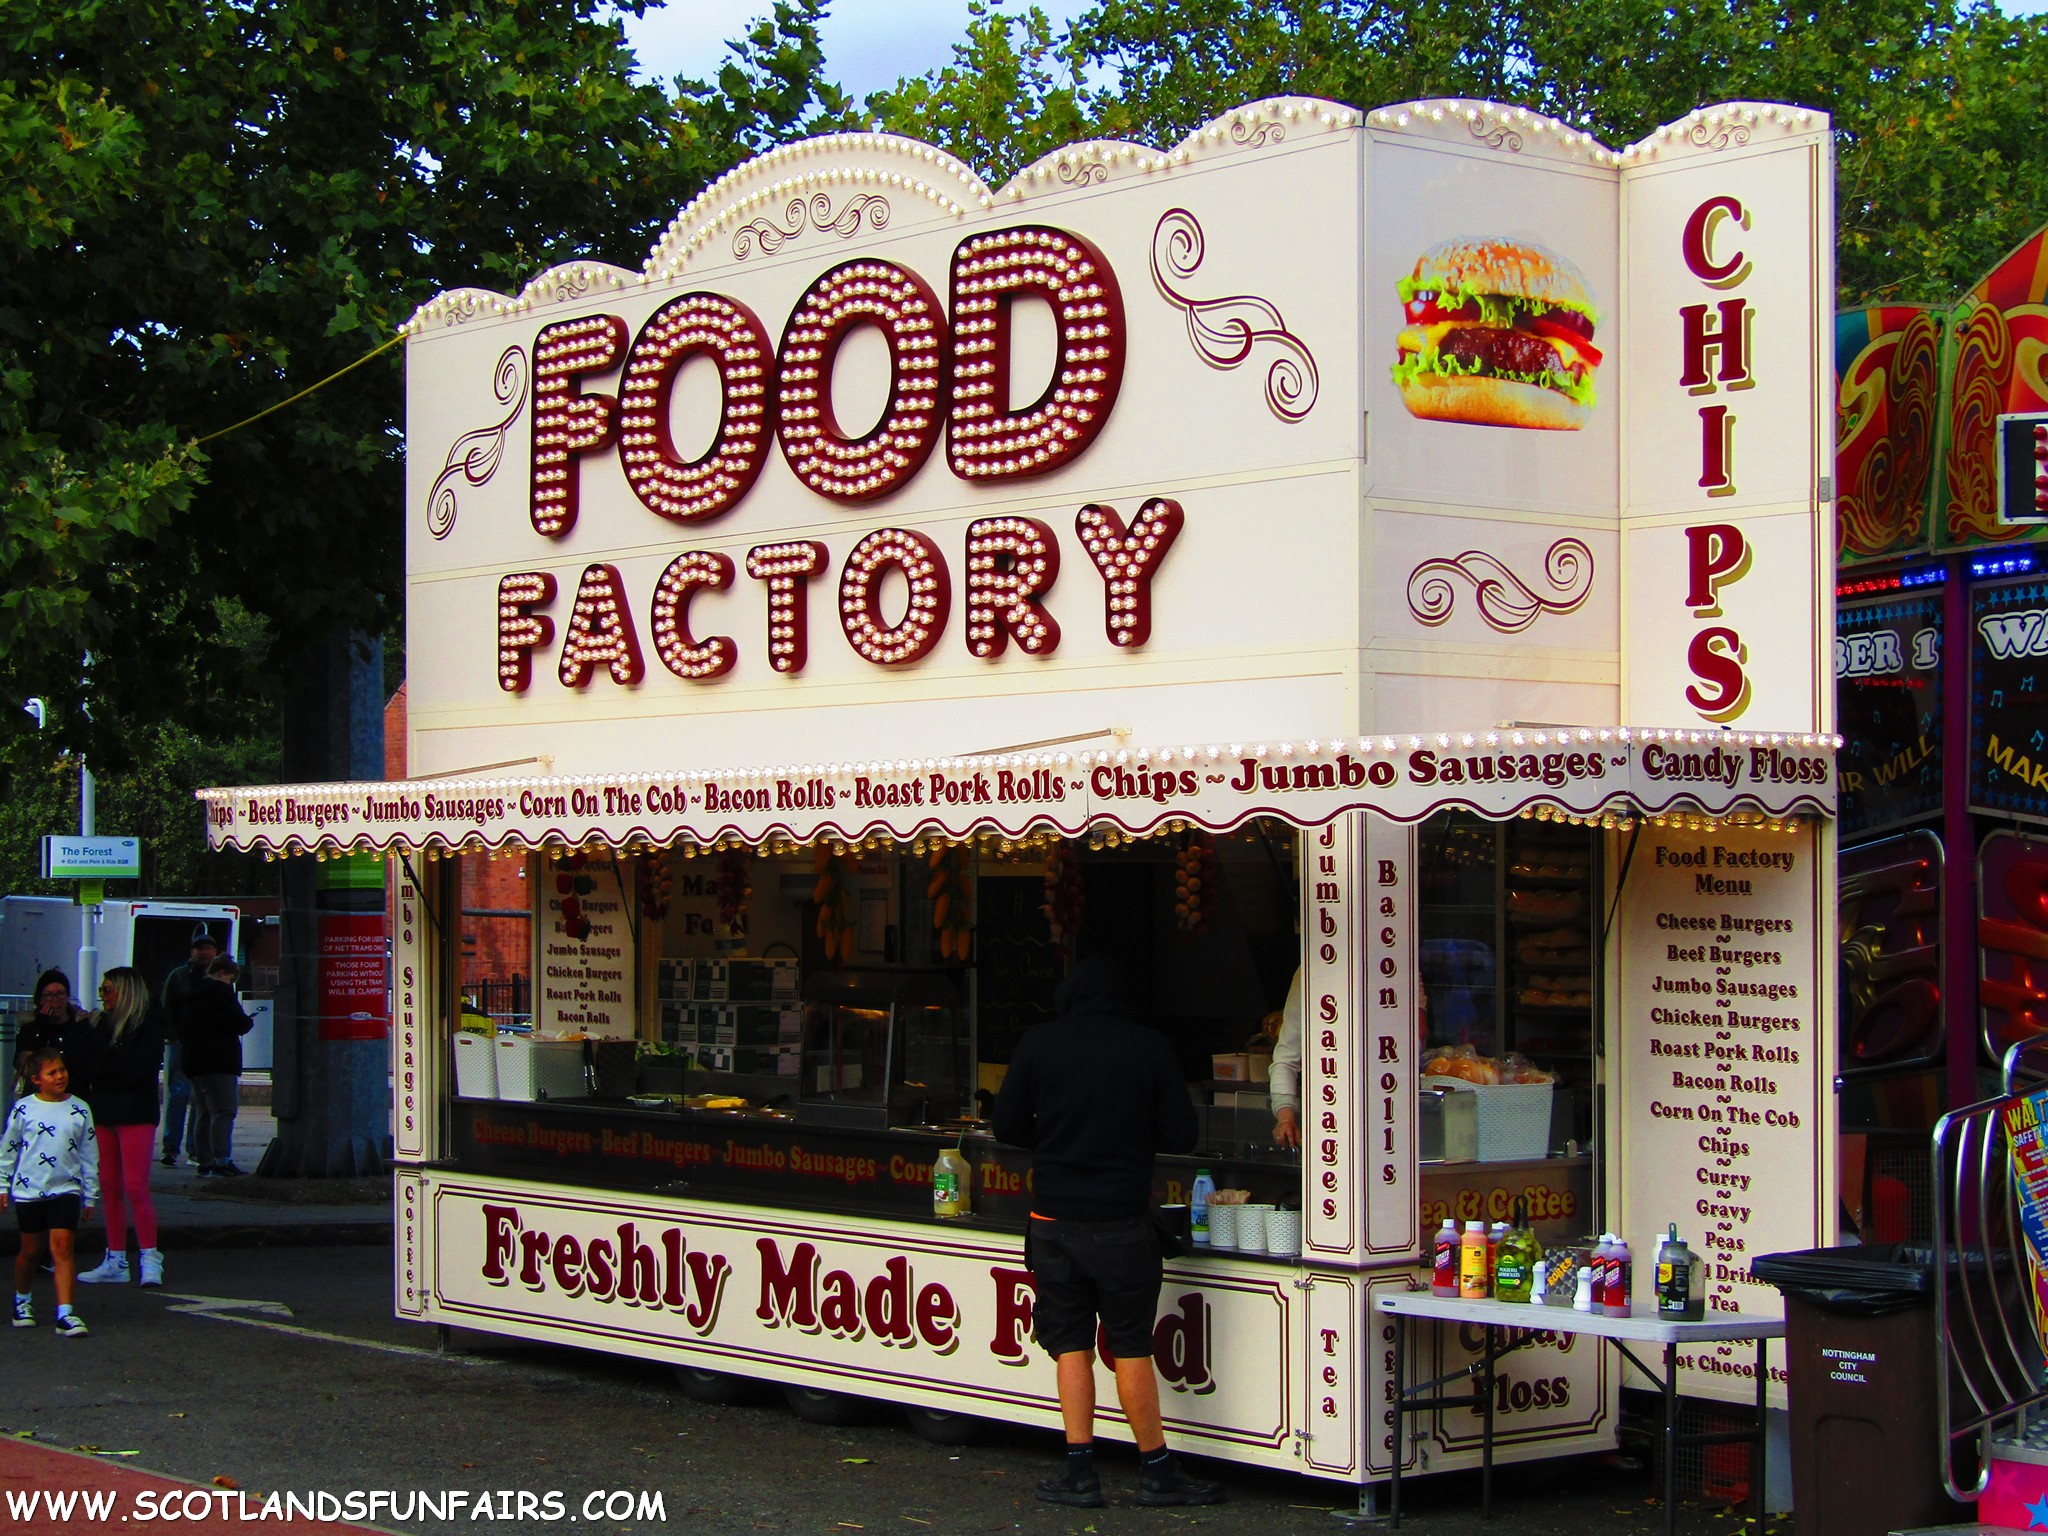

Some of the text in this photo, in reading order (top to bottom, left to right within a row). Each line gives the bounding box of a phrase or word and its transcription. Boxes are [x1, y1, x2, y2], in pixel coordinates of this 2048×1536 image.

[529, 224, 1127, 538] FOOD
[1679, 195, 1757, 724] CHIPS
[497, 497, 1185, 692] FACTORY
[1641, 742, 1828, 787] Candy Floss
[1872, 735, 1936, 786] WILL
[208, 750, 1605, 831] hips Beef Burgers Jumbo Sausages Corn On The Cob Bacon Rolls Roast Pork Rolls Chips Jumbo Sausages
[61, 847, 112, 856] The Forest
[1655, 846, 1794, 872] Food Factory
[1316, 824, 1340, 964] Jumbo
[1695, 873, 1752, 896] Menu
[1377, 858, 1399, 1008] Bacon
[1656, 912, 1793, 935] Cheese Burgers
[547, 943, 621, 960] Jumbo Sausages
[1666, 944, 1782, 967] Beef Burgers
[546, 966, 623, 982] Chicken Burgers
[546, 988, 622, 1004] Roast Pork Rolls
[1652, 976, 1798, 999] Jumbo Sausages
[557, 1010, 610, 1025] Bacon Rolls
[1650, 1007, 1801, 1032] Chicken Burgers
[403, 966, 415, 1132] Sausages
[1650, 1039, 1799, 1064] Roast Pork Rolls
[1672, 1071, 1777, 1094] Bacon Rolls
[1319, 993, 1340, 1221] Sausages
[1377, 1034, 1400, 1186] Rolls
[1650, 1101, 1800, 1128] Corn On The Cob
[1698, 1136, 1750, 1157] Chips
[2013, 1125, 2043, 1147] SAFETY
[473, 1117, 525, 1146] Cheese
[527, 1120, 592, 1157] Burgers
[601, 1127, 639, 1158] Beef
[641, 1131, 712, 1169] Burgers
[722, 1138, 785, 1171] Jumbo
[789, 1144, 877, 1186] Sausages
[980, 1161, 1021, 1195] The
[1696, 1167, 1751, 1191] Curry
[1420, 1184, 1577, 1230] ea & Coffee
[1696, 1198, 1751, 1221] Gravy
[404, 1184, 416, 1302] Coffee
[1705, 1231, 1745, 1251] Peas
[1716, 1263, 1772, 1287] Drin
[481, 1203, 1217, 1395] Freshly Made Fd
[1709, 1294, 1739, 1313] Tea
[1822, 1348, 1876, 1361] NOTTINGHAM
[1838, 1361, 1857, 1370] CITY
[1320, 1328, 1339, 1418] Tea
[1698, 1354, 1788, 1384] Chocolte
[1830, 1371, 1867, 1383] COUNCIL
